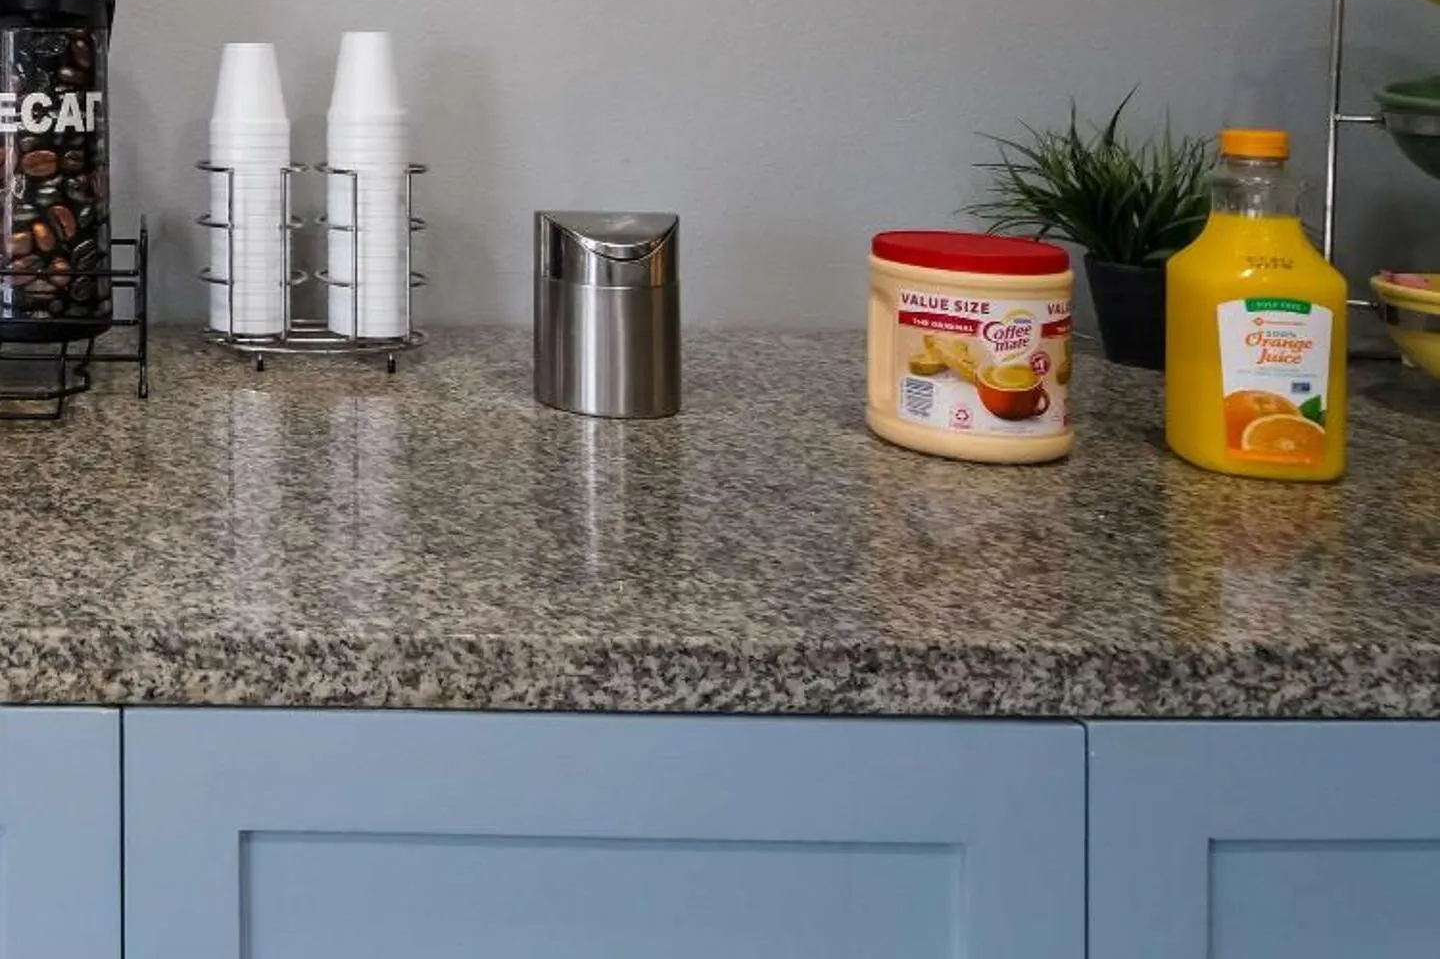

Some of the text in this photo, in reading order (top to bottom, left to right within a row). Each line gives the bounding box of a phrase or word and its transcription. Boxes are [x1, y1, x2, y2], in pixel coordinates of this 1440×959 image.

[901, 292, 990, 314] VALUE SIZE
[983, 321, 1033, 344] Coffee
[1245, 331, 1313, 353] Orange
[1256, 348, 1303, 364] Juice
